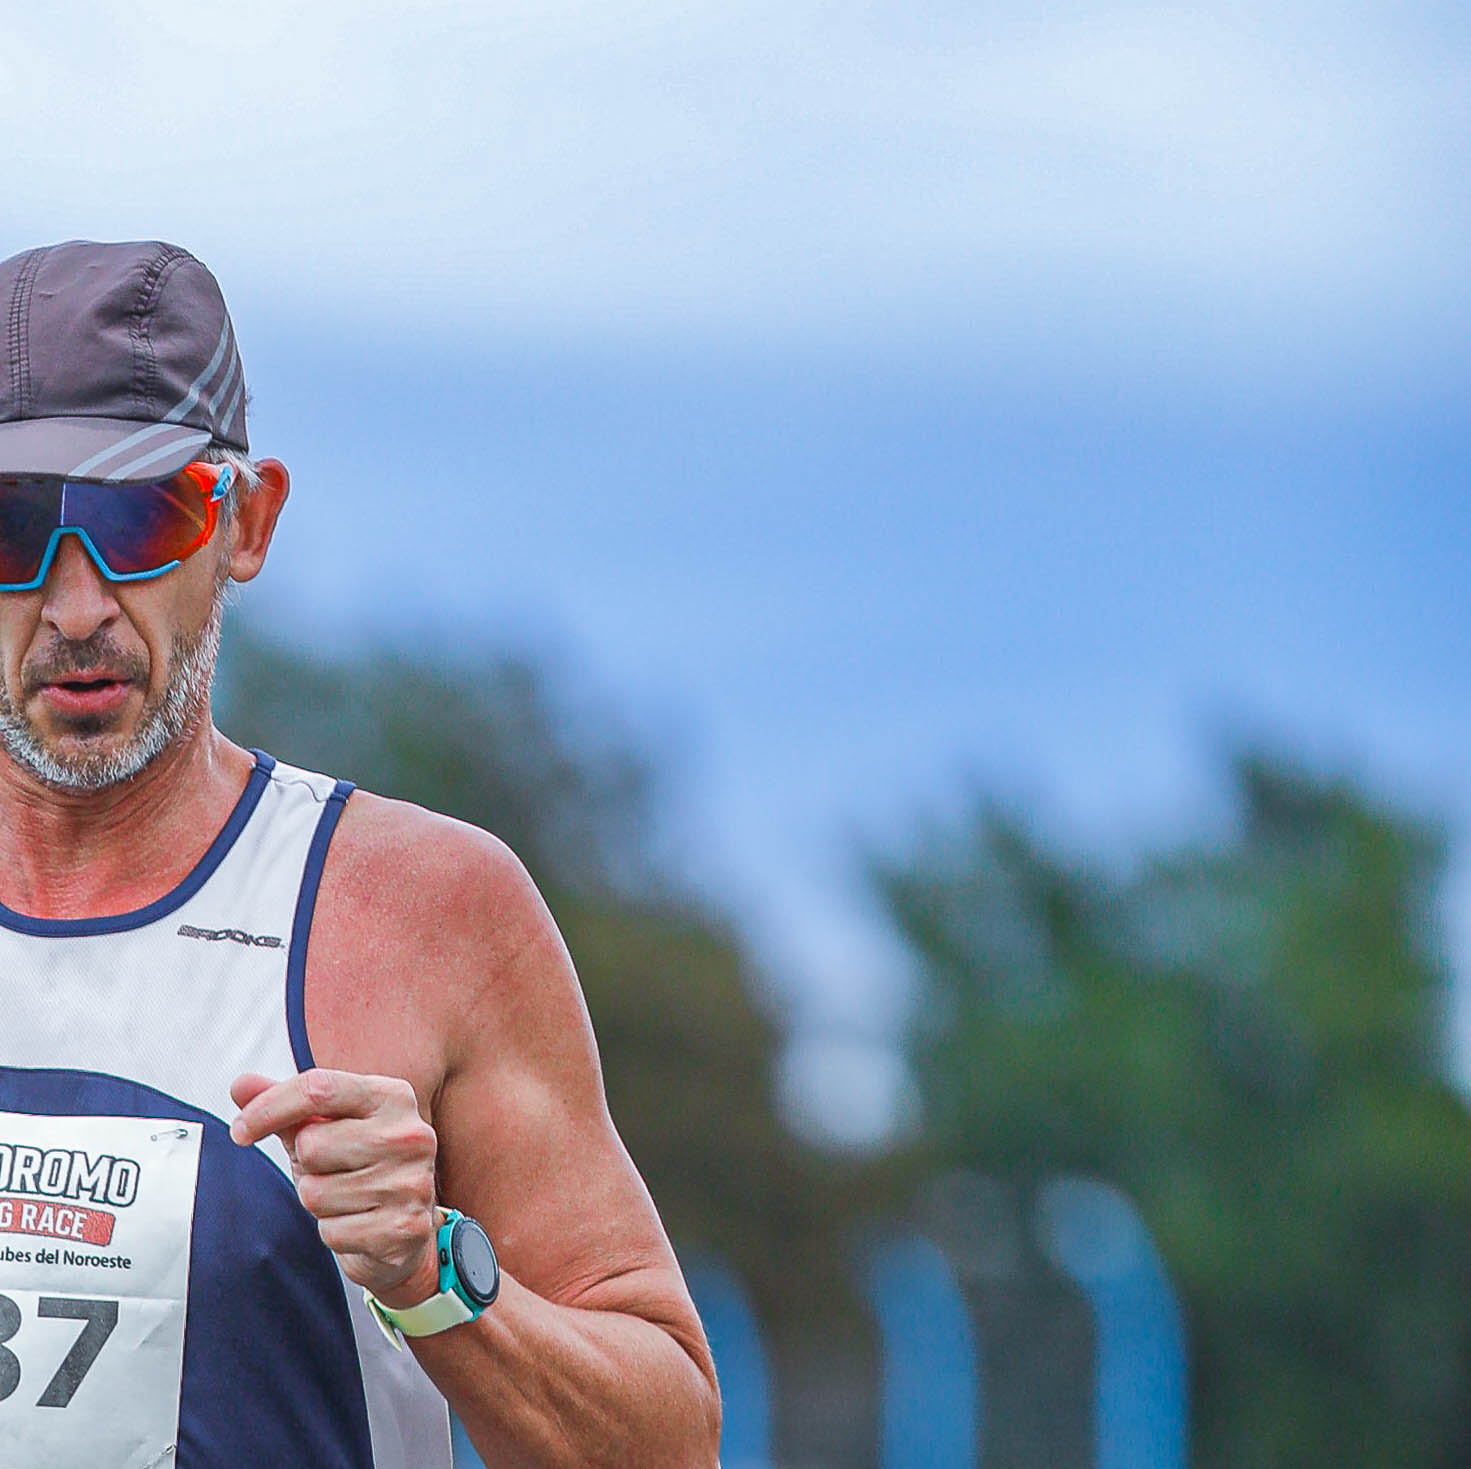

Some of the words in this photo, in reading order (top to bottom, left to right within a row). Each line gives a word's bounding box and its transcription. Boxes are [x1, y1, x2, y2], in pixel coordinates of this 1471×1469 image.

[21, 1202, 89, 1239] RACE
[35, 1248, 59, 1264] del
[63, 1250, 132, 1269] Noroeste
